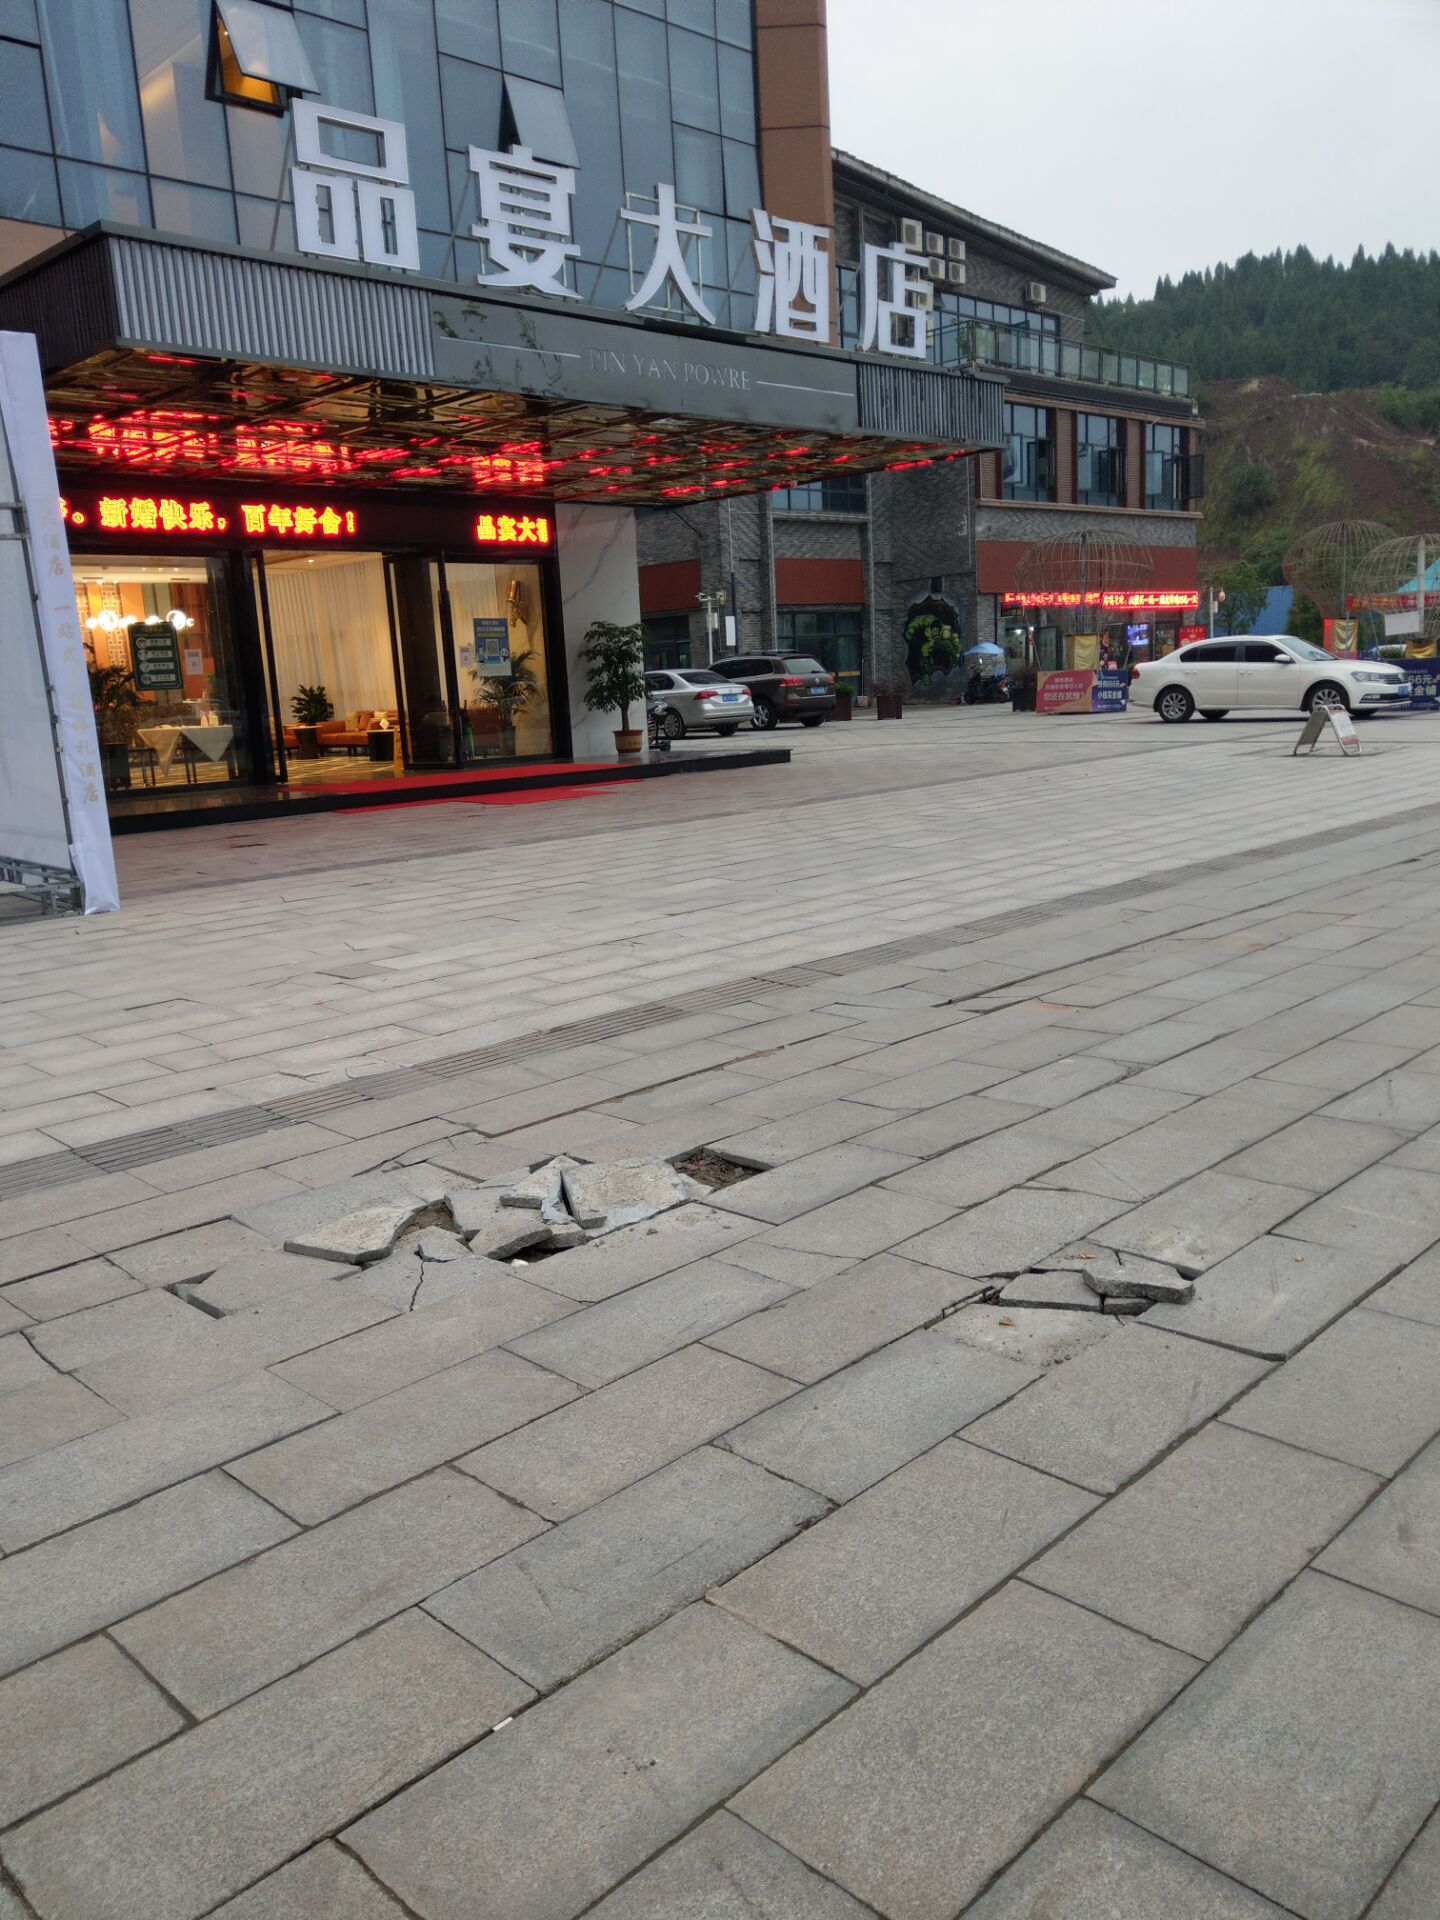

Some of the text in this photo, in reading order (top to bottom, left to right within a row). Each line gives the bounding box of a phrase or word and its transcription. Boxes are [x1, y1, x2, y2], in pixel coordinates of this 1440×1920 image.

[290, 97, 934, 360] 品宴大酒店
[588, 346, 752, 392] PIN YAN POWRE
